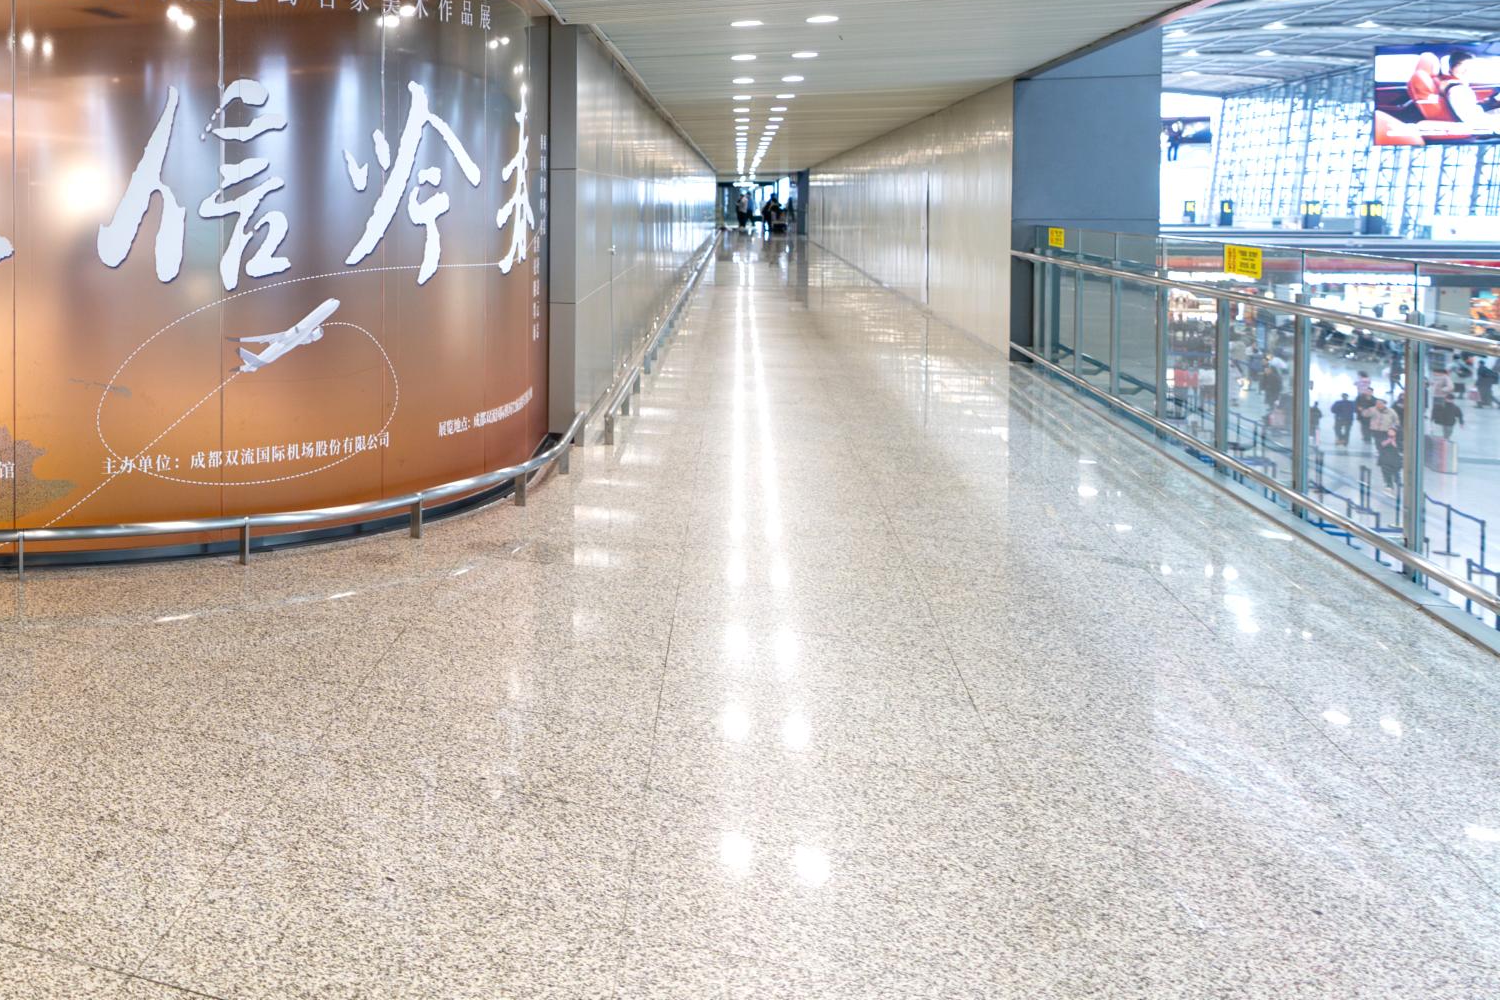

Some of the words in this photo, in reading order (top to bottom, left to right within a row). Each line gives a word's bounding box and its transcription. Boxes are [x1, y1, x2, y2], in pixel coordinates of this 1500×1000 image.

[100, 431, 391, 475] 主办单位：成都双流国际机场股份有限公司
